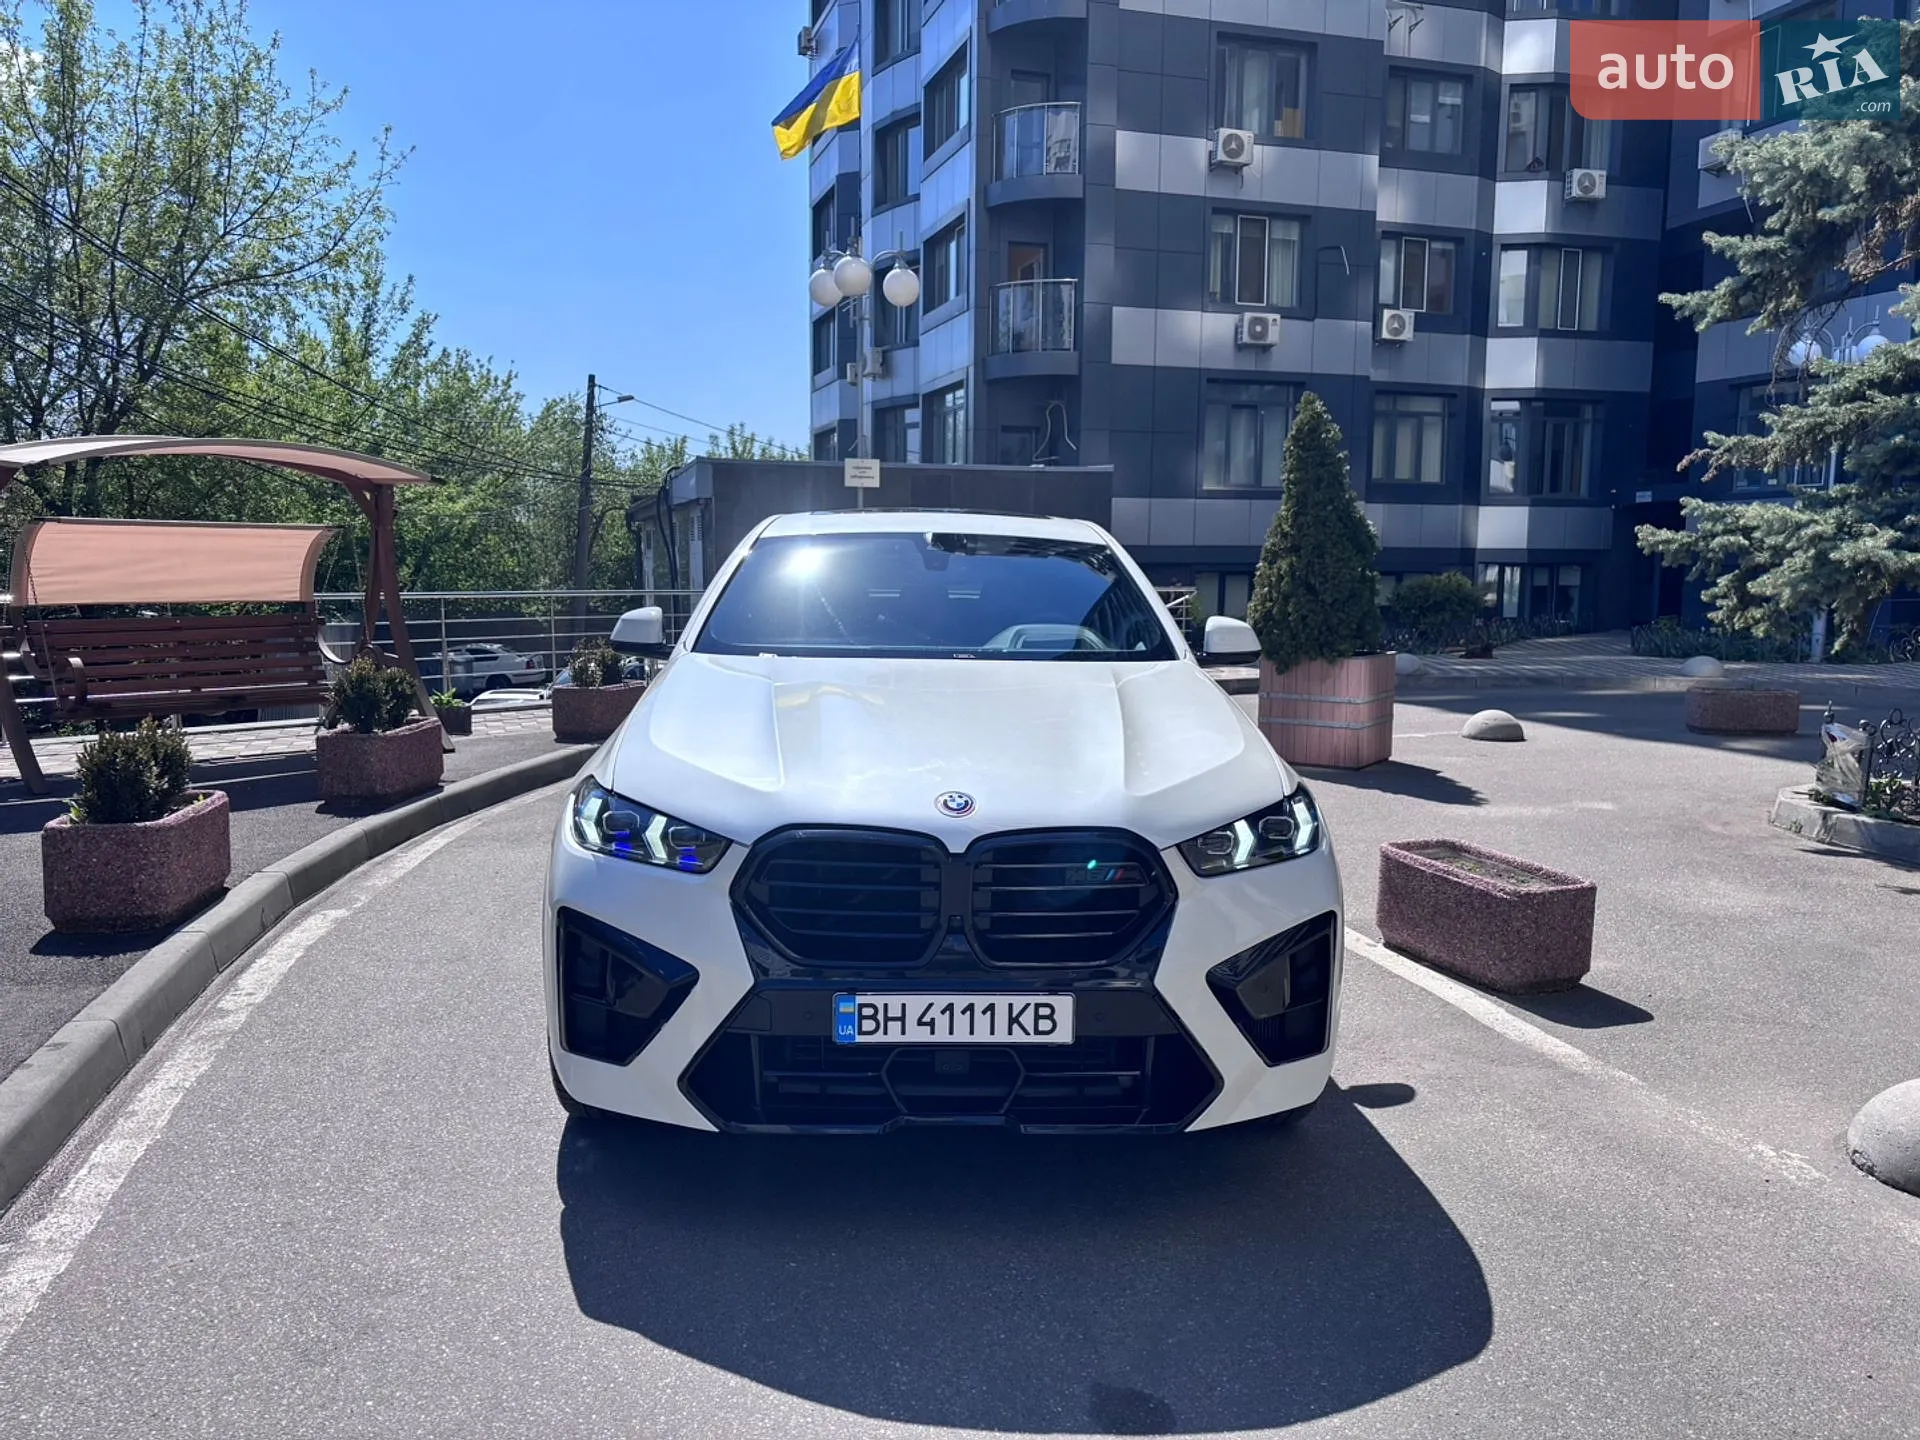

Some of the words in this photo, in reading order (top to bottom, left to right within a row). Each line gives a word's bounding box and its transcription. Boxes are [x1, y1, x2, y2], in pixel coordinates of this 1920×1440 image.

[857, 1002, 907, 1036] BH
[916, 1002, 996, 1036] 4111
[1007, 1002, 1058, 1036] KB
[838, 1025, 854, 1036] UA
